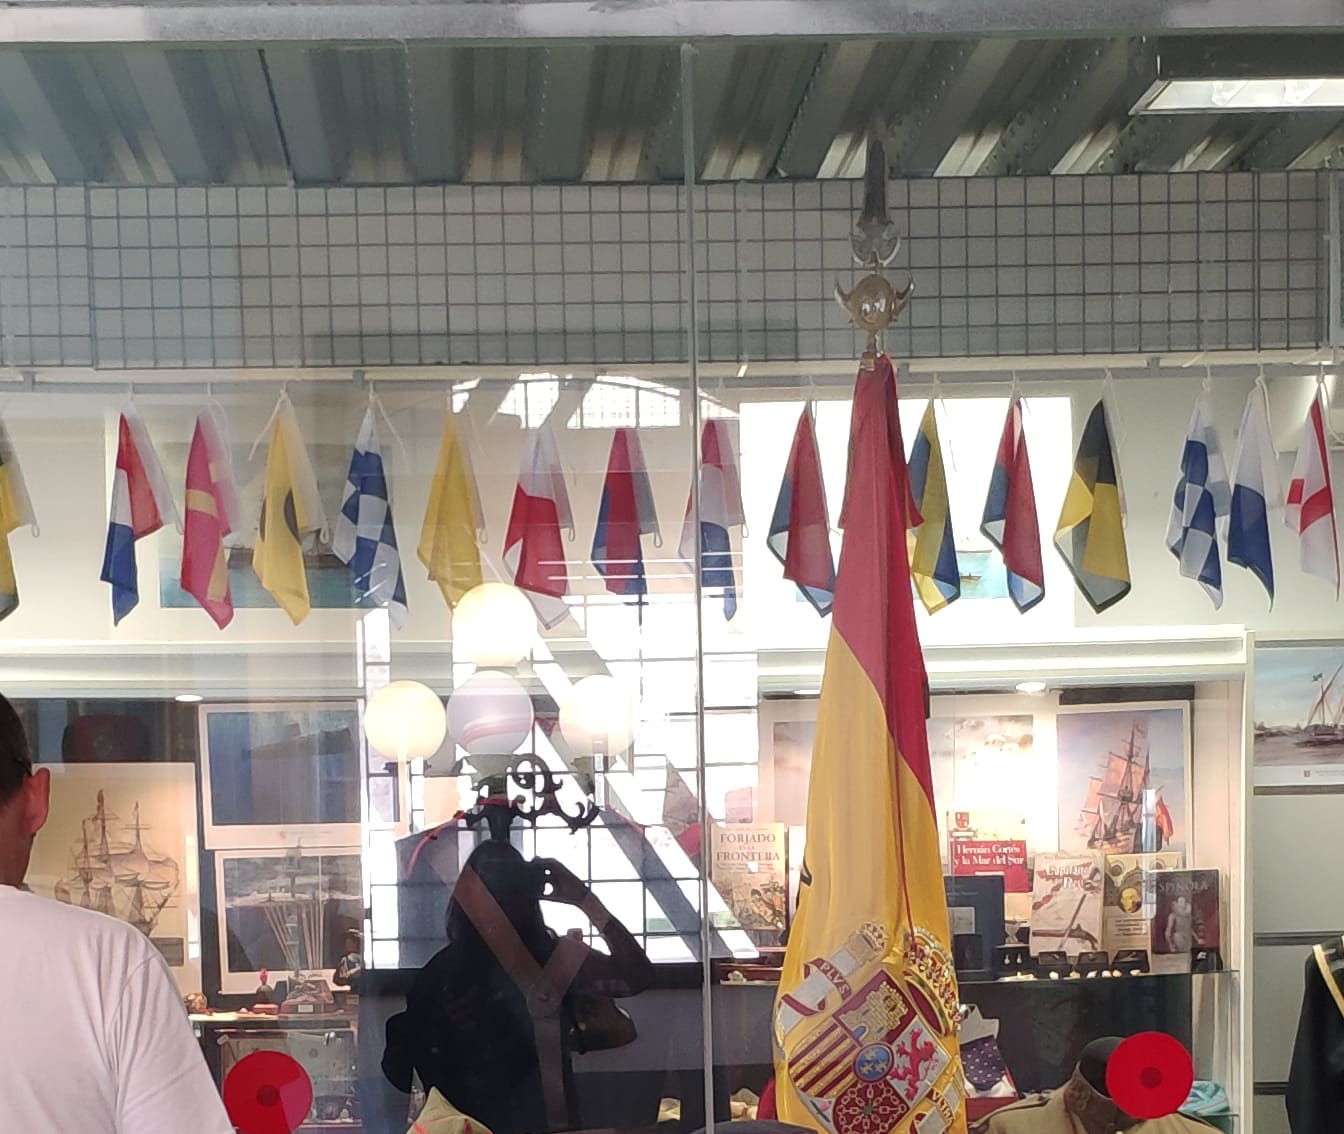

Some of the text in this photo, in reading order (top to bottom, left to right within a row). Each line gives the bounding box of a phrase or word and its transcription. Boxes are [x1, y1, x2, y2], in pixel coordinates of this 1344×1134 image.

[719, 833, 777, 845] FORJADO
[957, 843, 1020, 855] Hernán Cortés
[716, 851, 780, 862] FRONTERA
[962, 855, 971, 865] la
[972, 855, 992, 865] Mar
[992, 855, 1006, 865] del
[1007, 856, 1025, 866] Sur
[818, 961, 851, 995] PLVS
